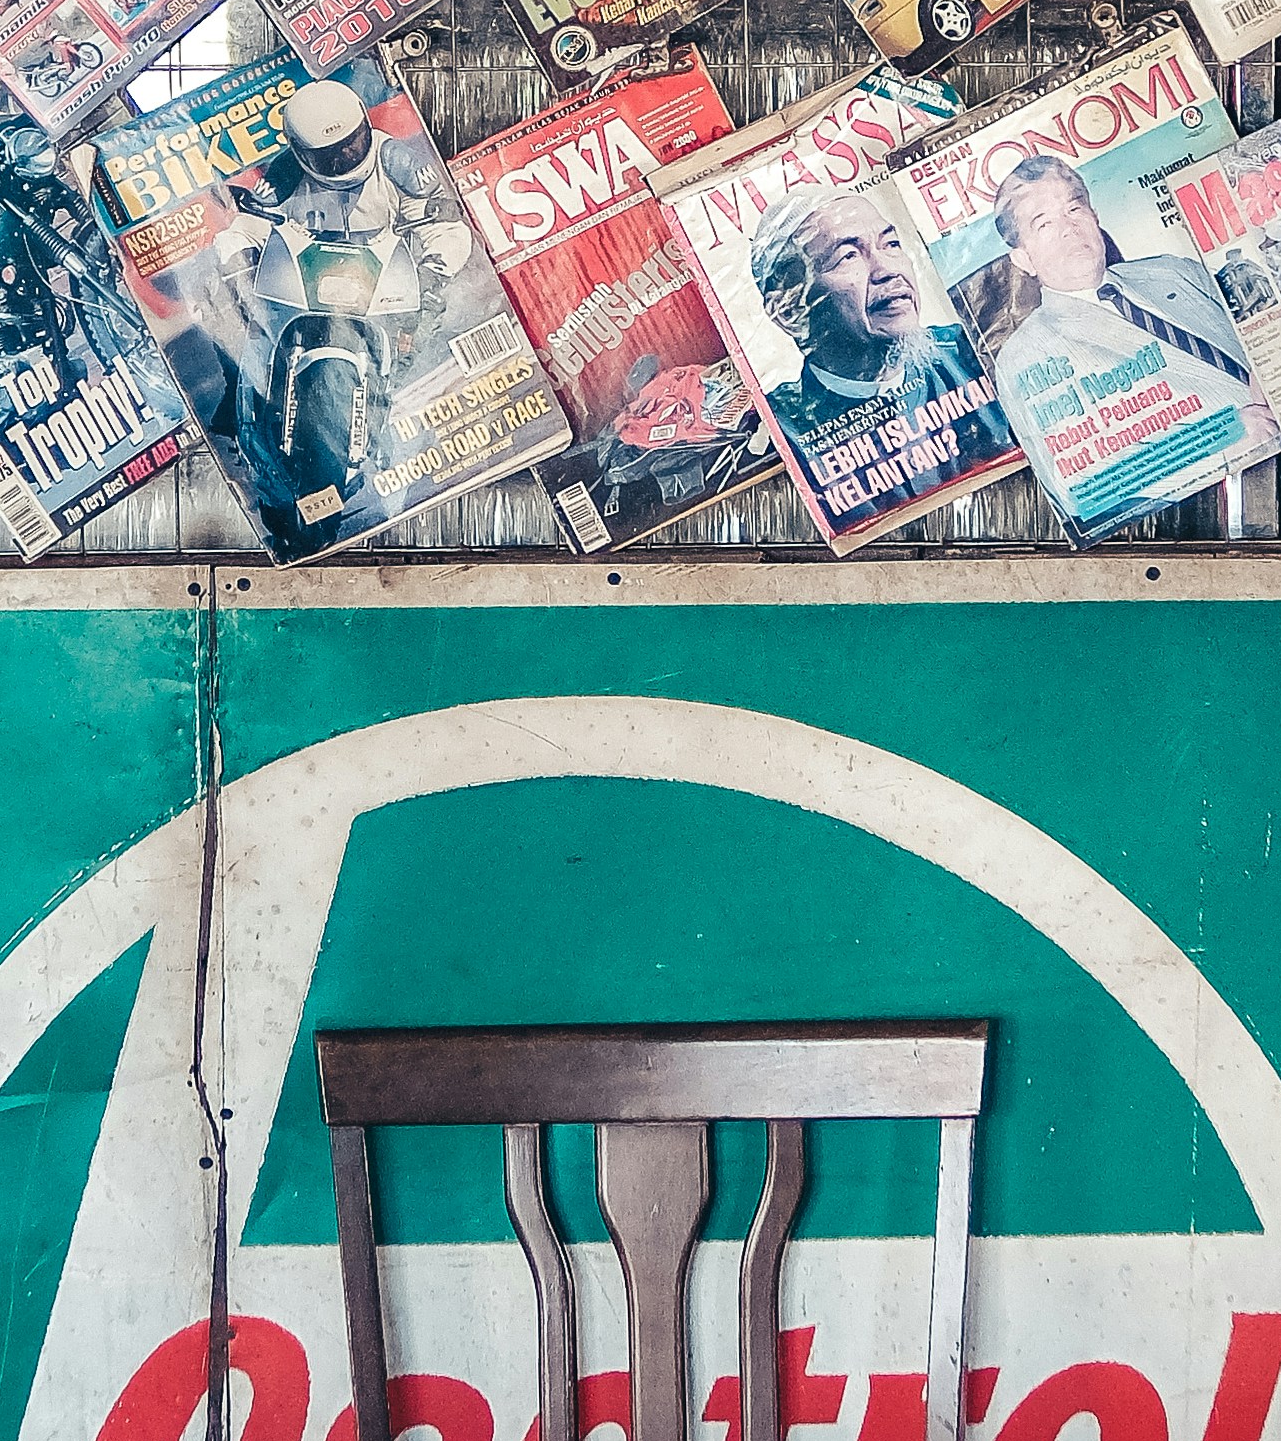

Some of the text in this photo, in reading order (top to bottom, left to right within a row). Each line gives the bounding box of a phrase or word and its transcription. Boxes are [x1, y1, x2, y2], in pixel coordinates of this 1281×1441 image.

[106, 78, 298, 182] Performance
[910, 141, 974, 183] DEWAN
[918, 55, 1199, 231] EKONOMI
[0, 357, 63, 411] Top
[461, 359, 535, 410] SINGLES
[6, 357, 155, 493] Trophy!
[444, 426, 494, 472] ROAD
[502, 390, 553, 438] RACE
[808, 432, 880, 486] LEBIH
[80, 488, 105, 516] Very
[103, 476, 128, 502] Best
[124, 454, 153, 484] FREE
[822, 429, 961, 517] KELANTAN?
